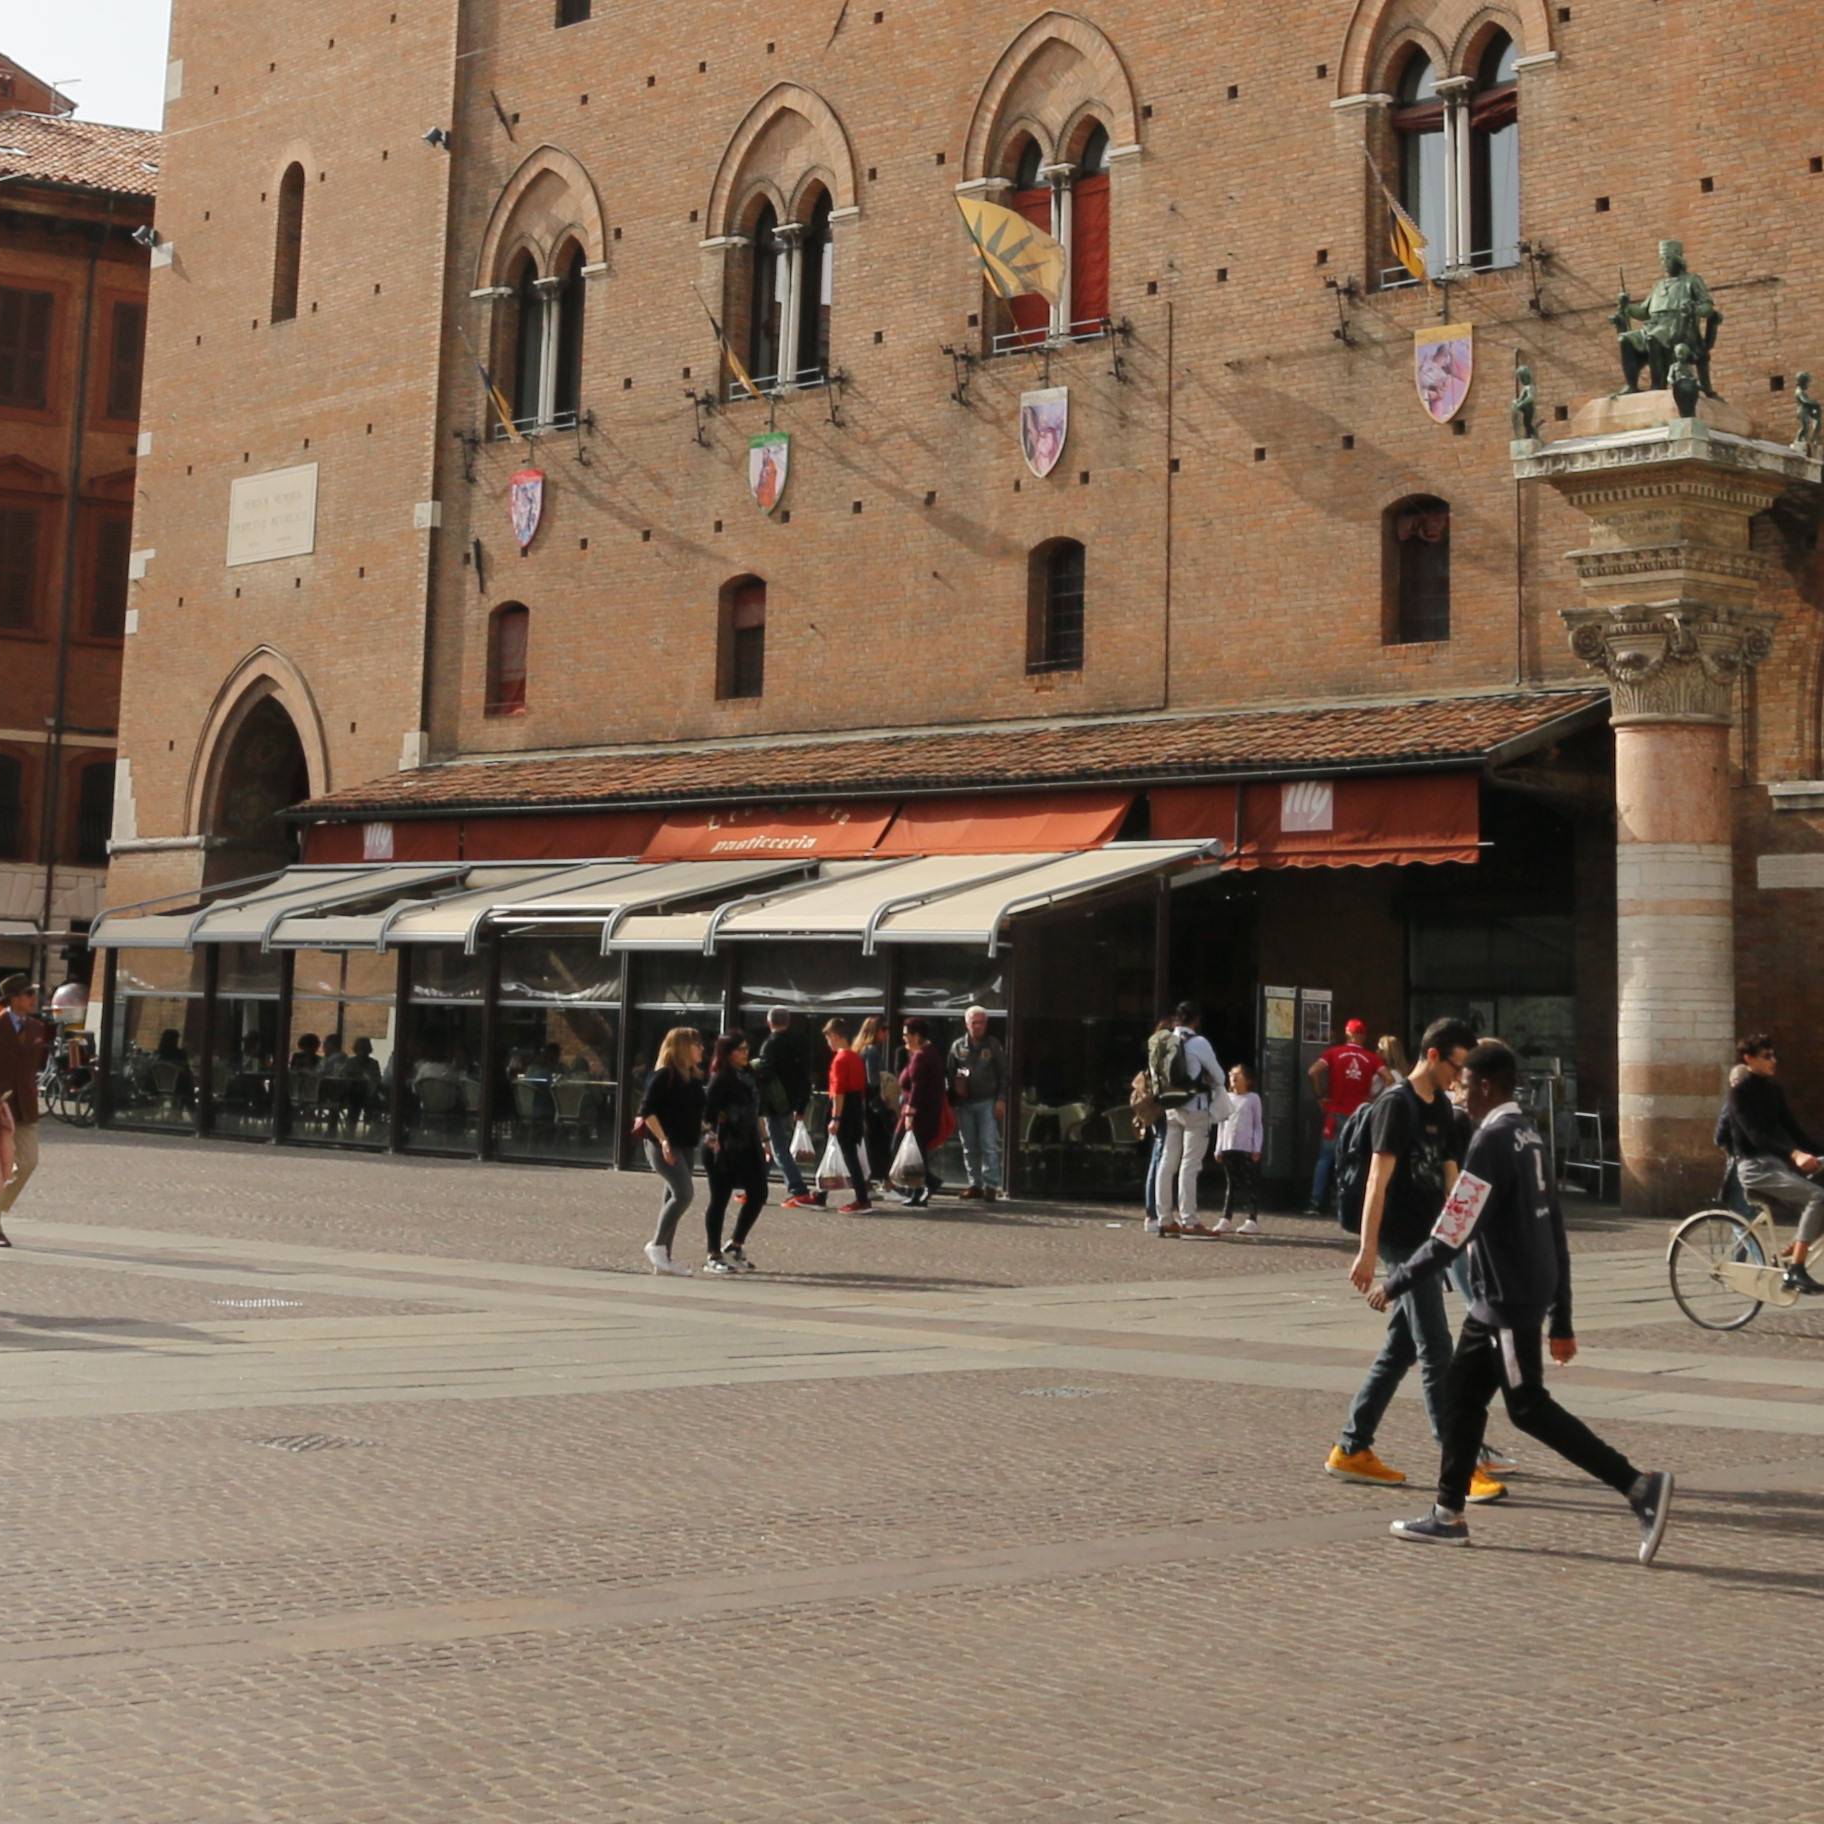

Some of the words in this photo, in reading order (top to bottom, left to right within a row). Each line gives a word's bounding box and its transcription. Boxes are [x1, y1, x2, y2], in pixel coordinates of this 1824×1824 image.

[1284, 781, 1330, 824] illy
[365, 822, 393, 855] illy
[709, 834, 818, 855] pasticceria
